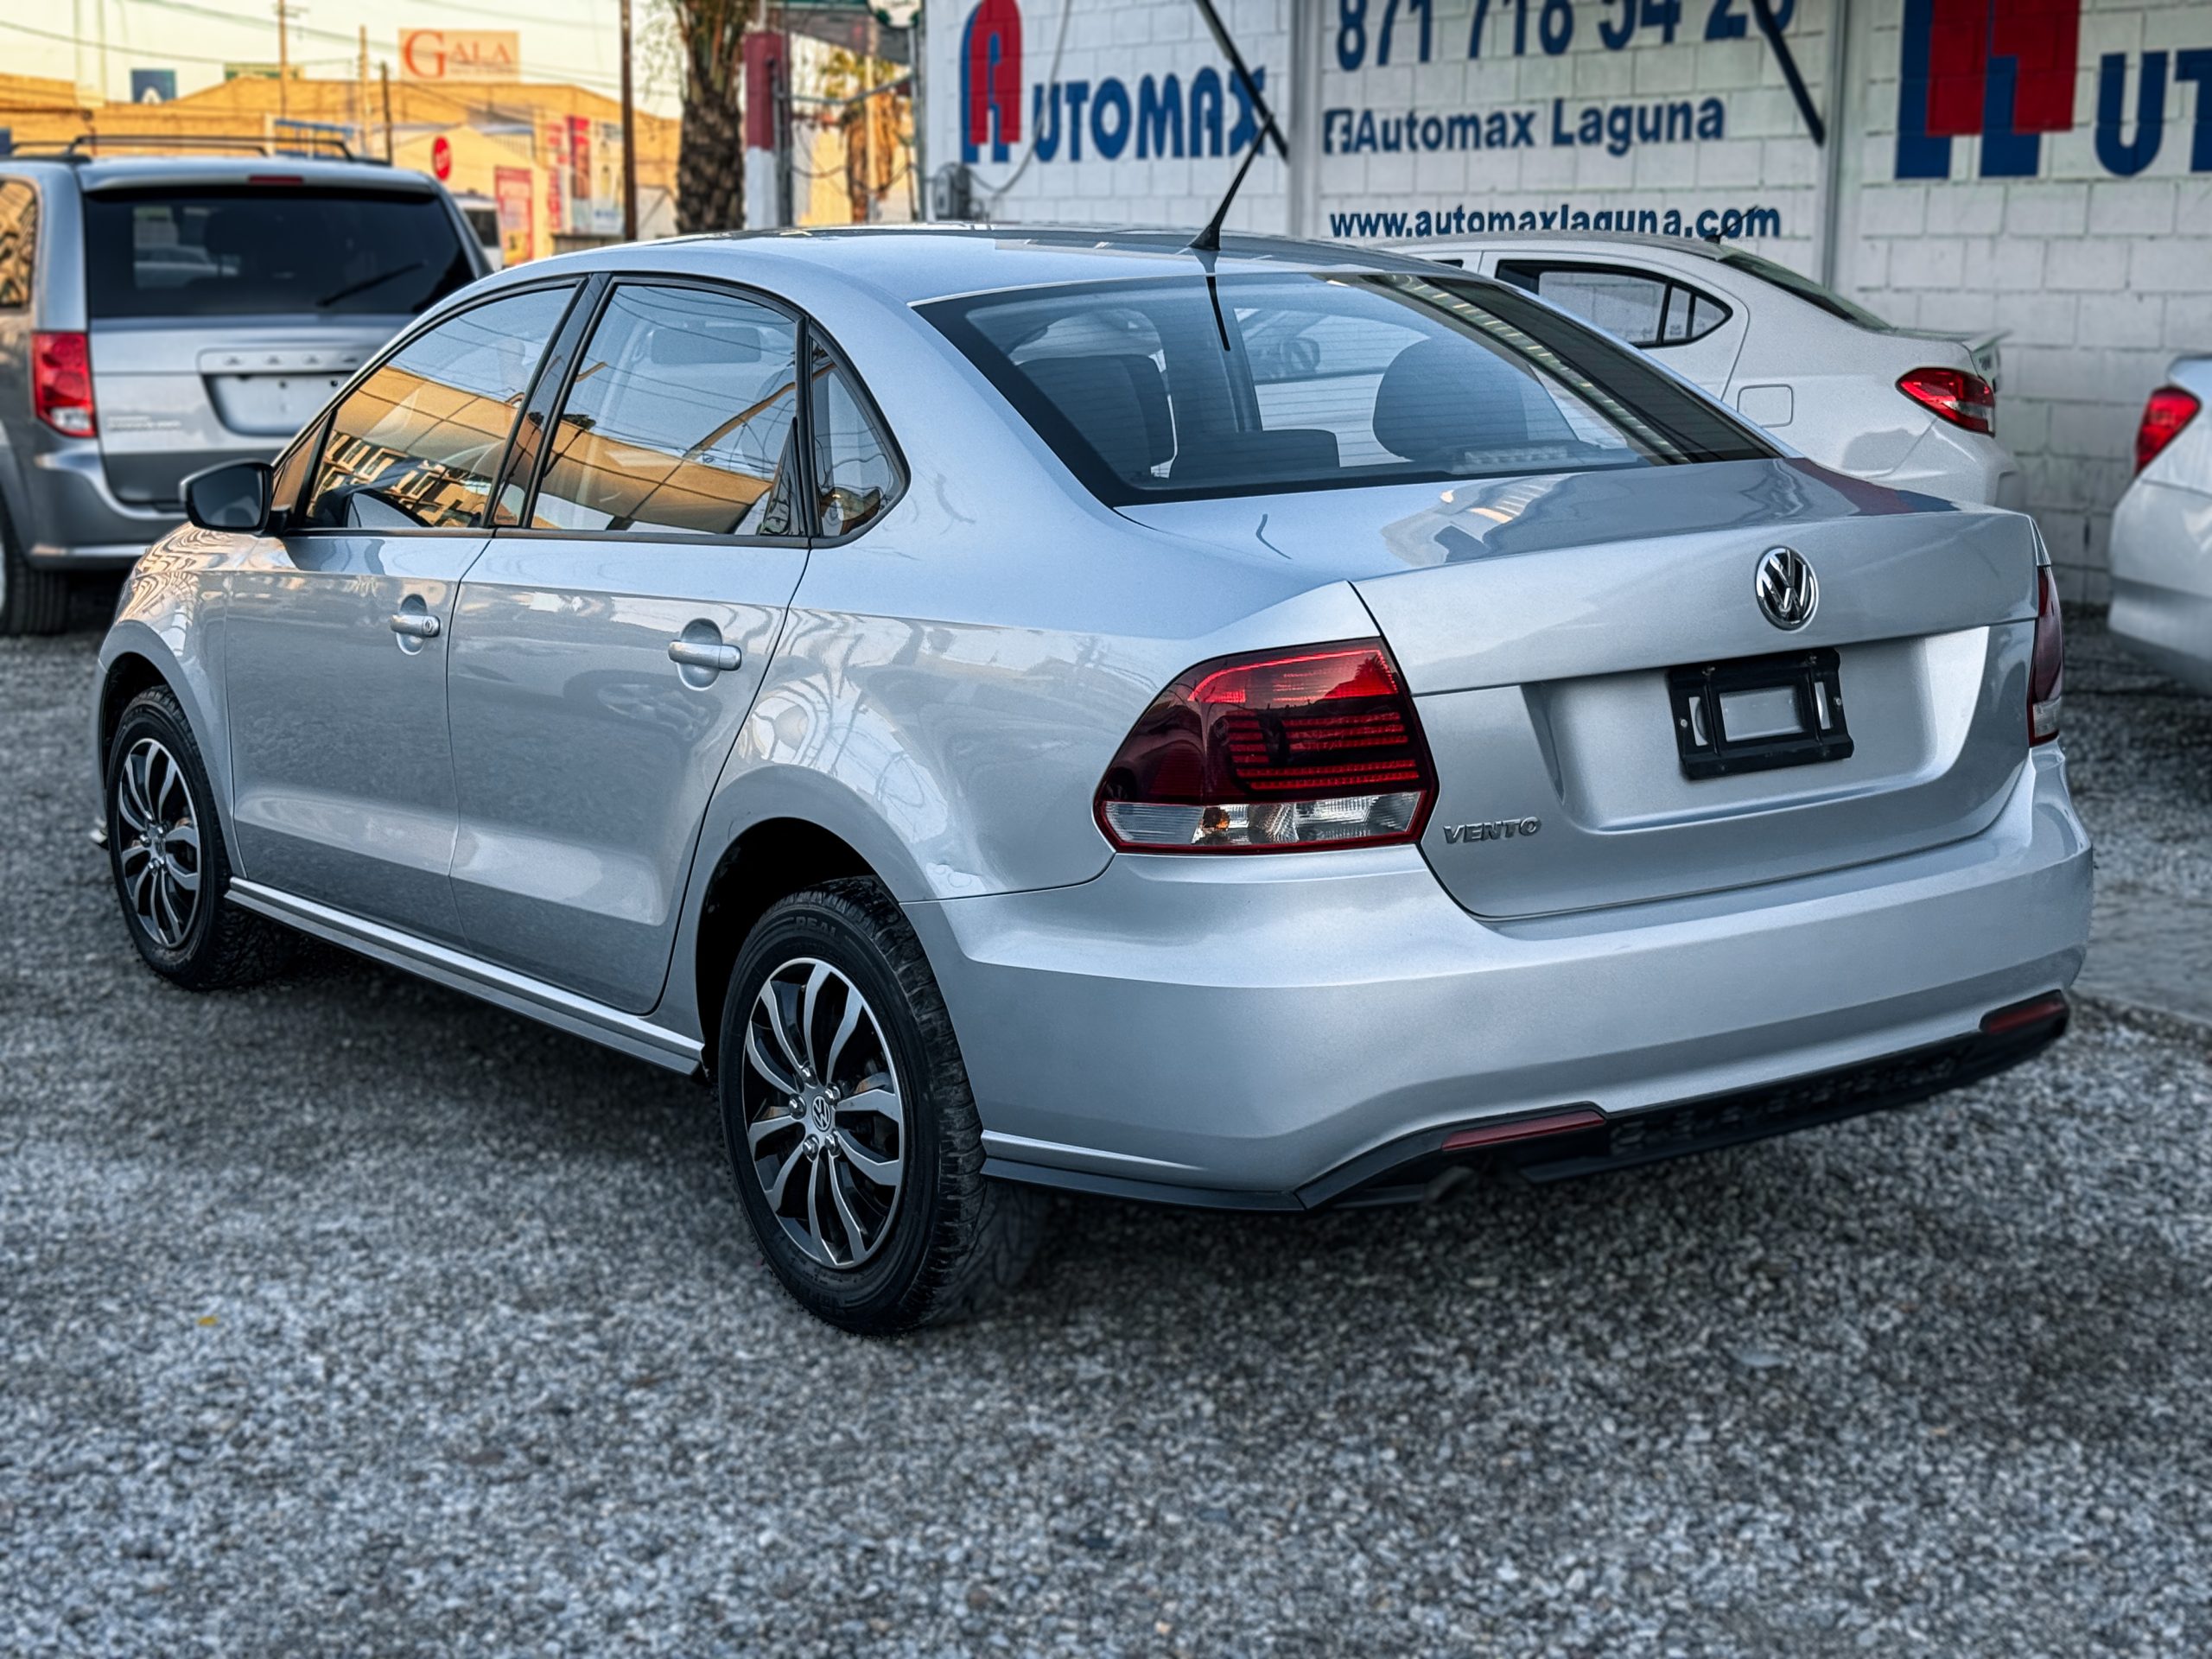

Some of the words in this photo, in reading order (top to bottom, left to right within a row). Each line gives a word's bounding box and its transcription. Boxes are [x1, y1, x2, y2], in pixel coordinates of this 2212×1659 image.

[402, 29, 513, 79] GALA
[1353, 108, 1536, 153] Automax
[1552, 96, 1725, 157] Laguna
[1329, 204, 1781, 238] www.automaxlaguna.com
[1443, 817, 1541, 844] VENTO
